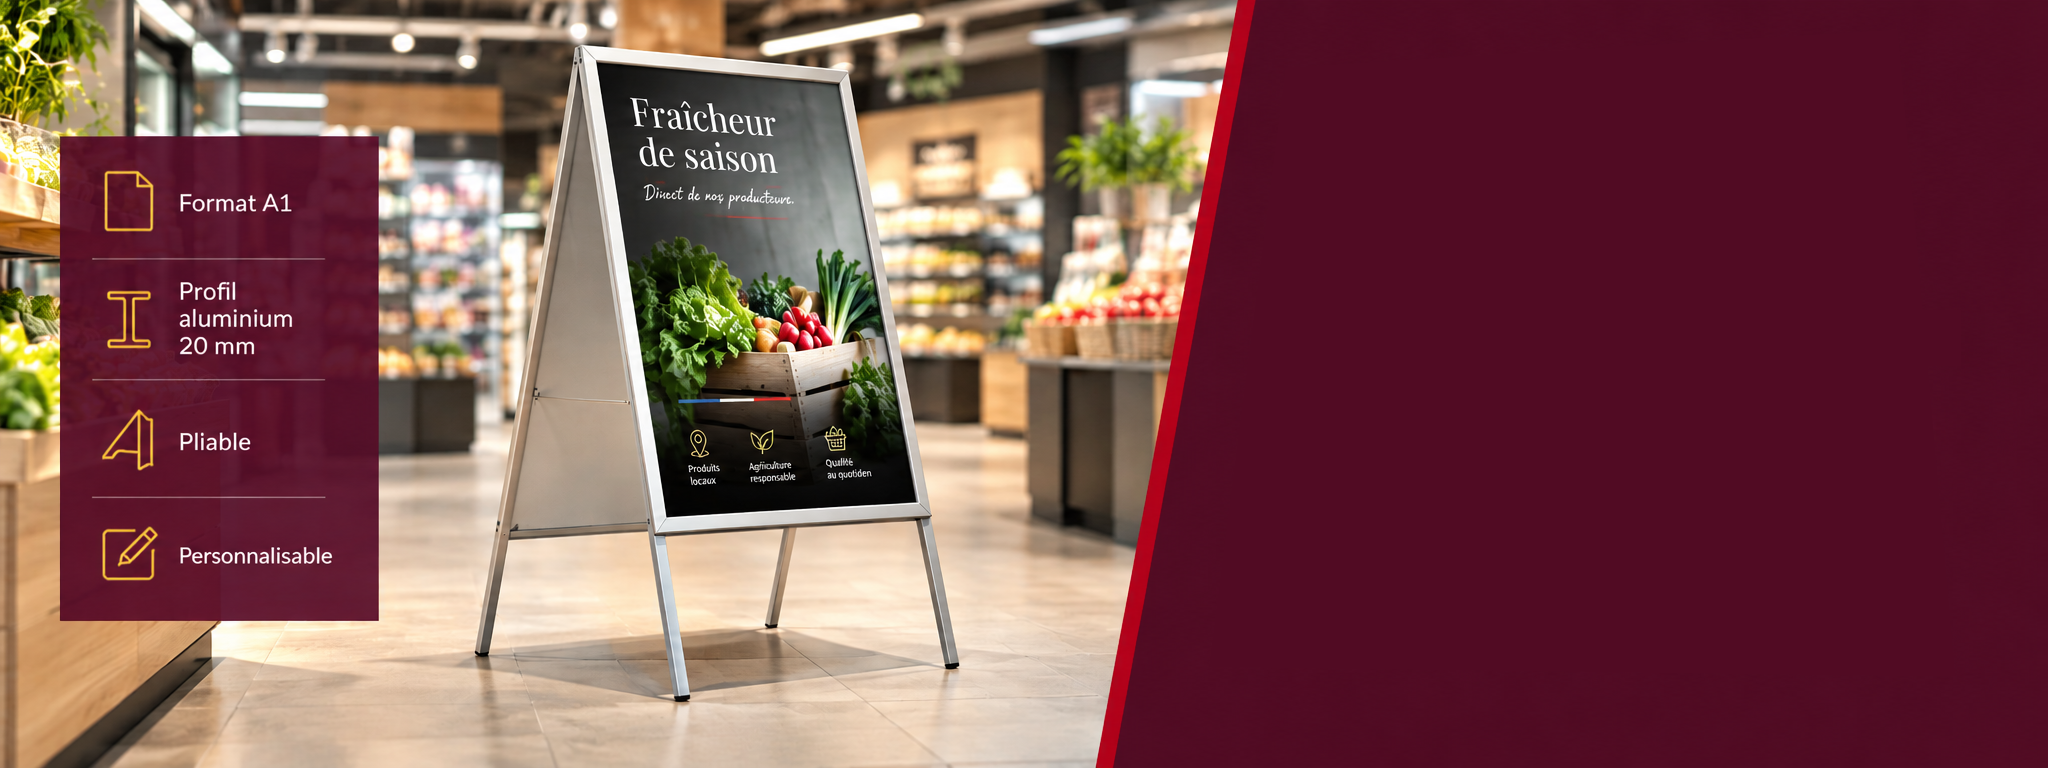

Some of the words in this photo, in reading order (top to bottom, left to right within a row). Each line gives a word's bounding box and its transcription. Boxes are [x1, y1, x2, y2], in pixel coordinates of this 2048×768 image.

[629, 97, 777, 138] Fraîcheur
[639, 136, 676, 169] de
[684, 141, 779, 174] saison
[687, 185, 701, 201] de
[687, 463, 721, 473] Produits
[689, 476, 717, 486] locaux
[750, 471, 796, 484] responsable
[827, 472, 837, 480] au
